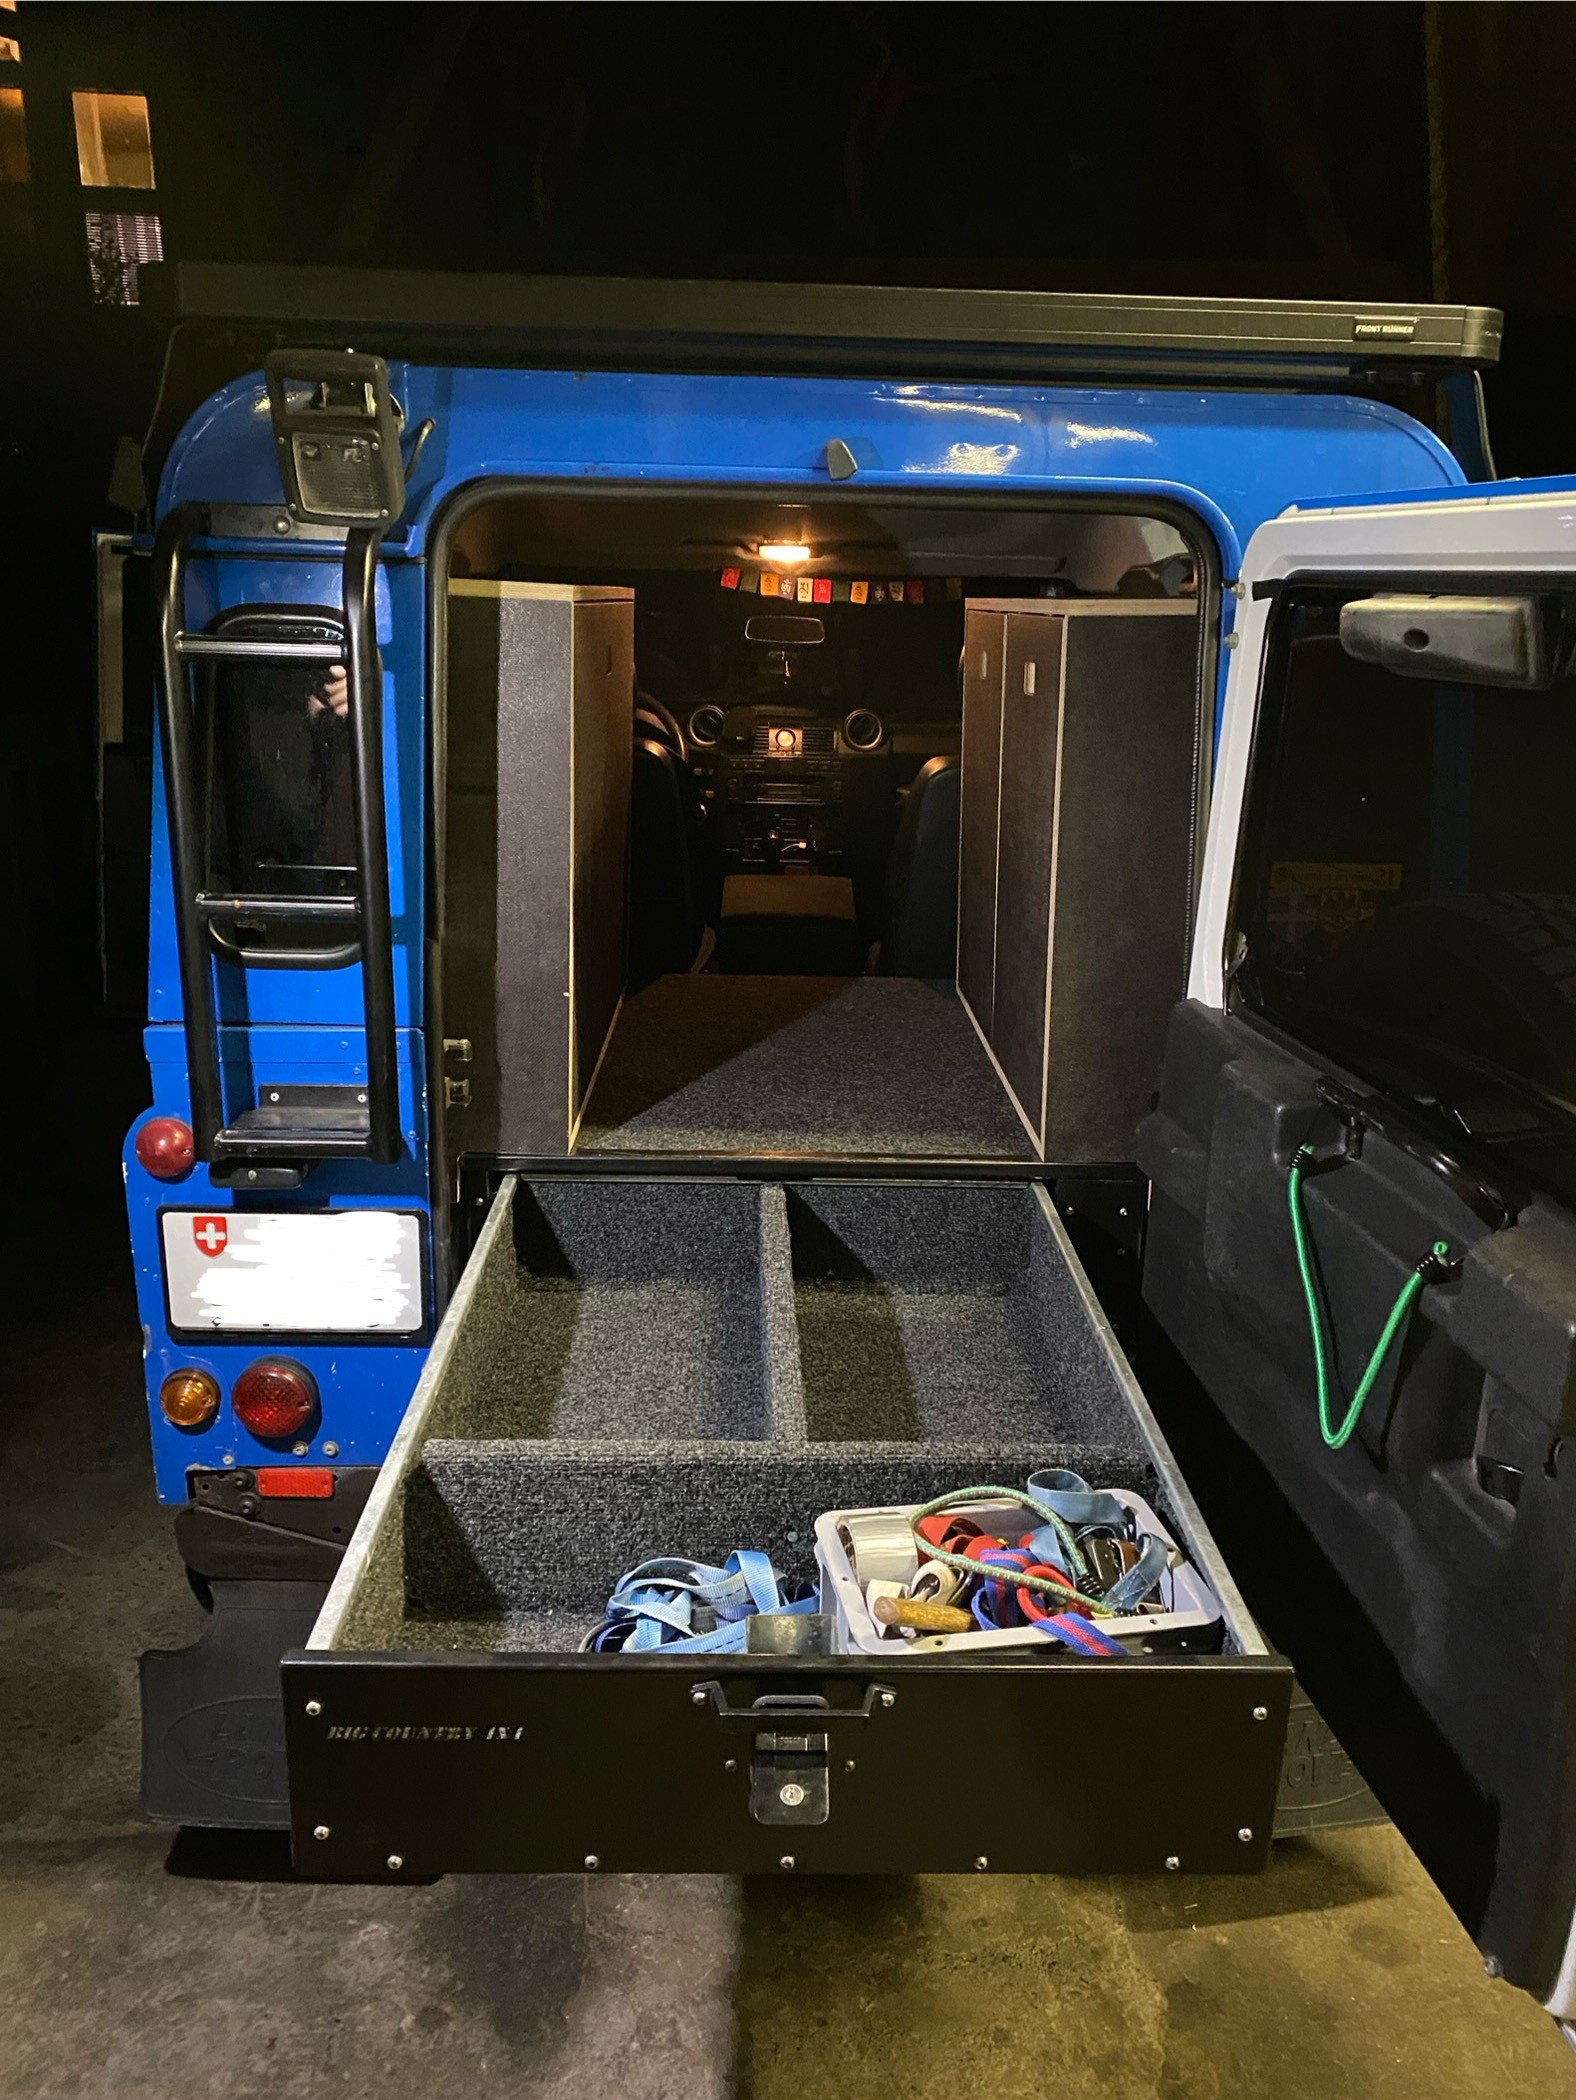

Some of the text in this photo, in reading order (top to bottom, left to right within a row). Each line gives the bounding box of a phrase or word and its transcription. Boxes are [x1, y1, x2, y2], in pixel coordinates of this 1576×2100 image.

[1355, 324, 1415, 334] FRONT RUNNER
[327, 1725, 369, 1740] BIG
[371, 1725, 478, 1740] COUNTRY
